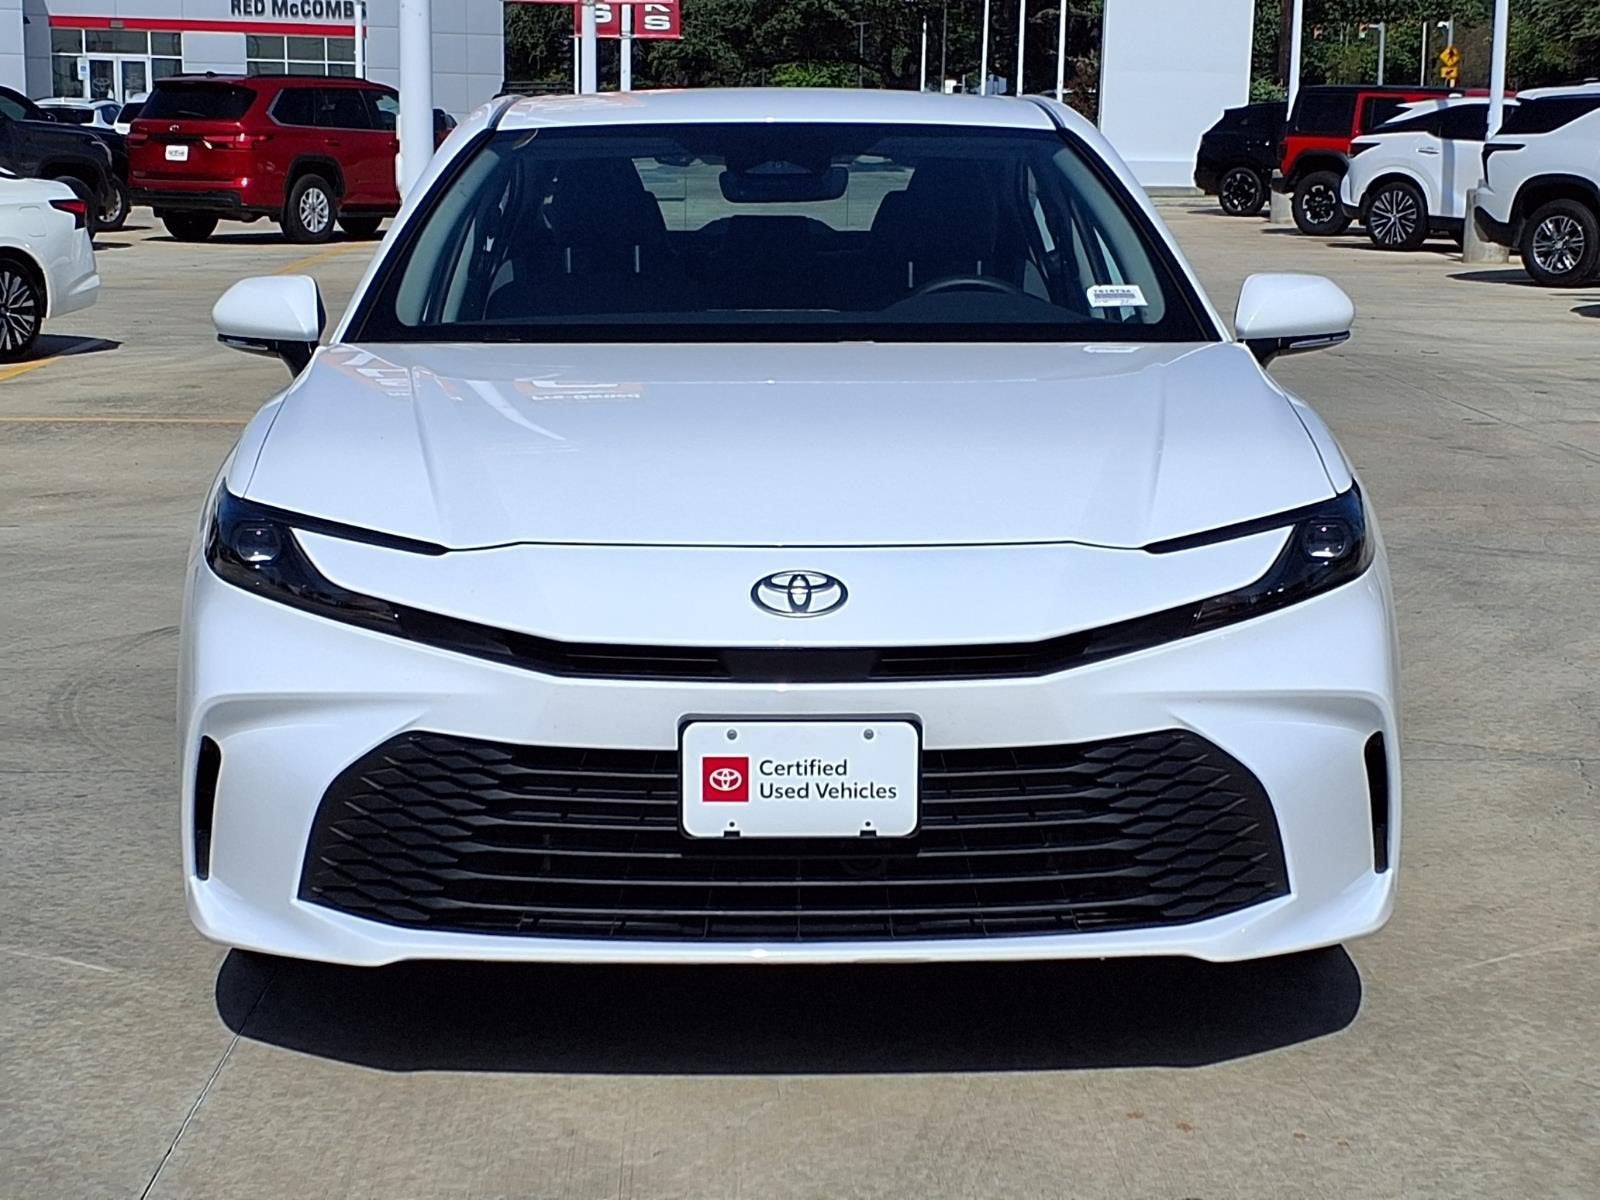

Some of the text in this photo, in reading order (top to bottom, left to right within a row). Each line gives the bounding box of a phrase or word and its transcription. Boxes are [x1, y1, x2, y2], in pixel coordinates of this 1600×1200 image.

[231, 0, 266, 16] RED
[759, 759, 848, 776] Certified
[760, 782, 897, 799] Used Vehicles
